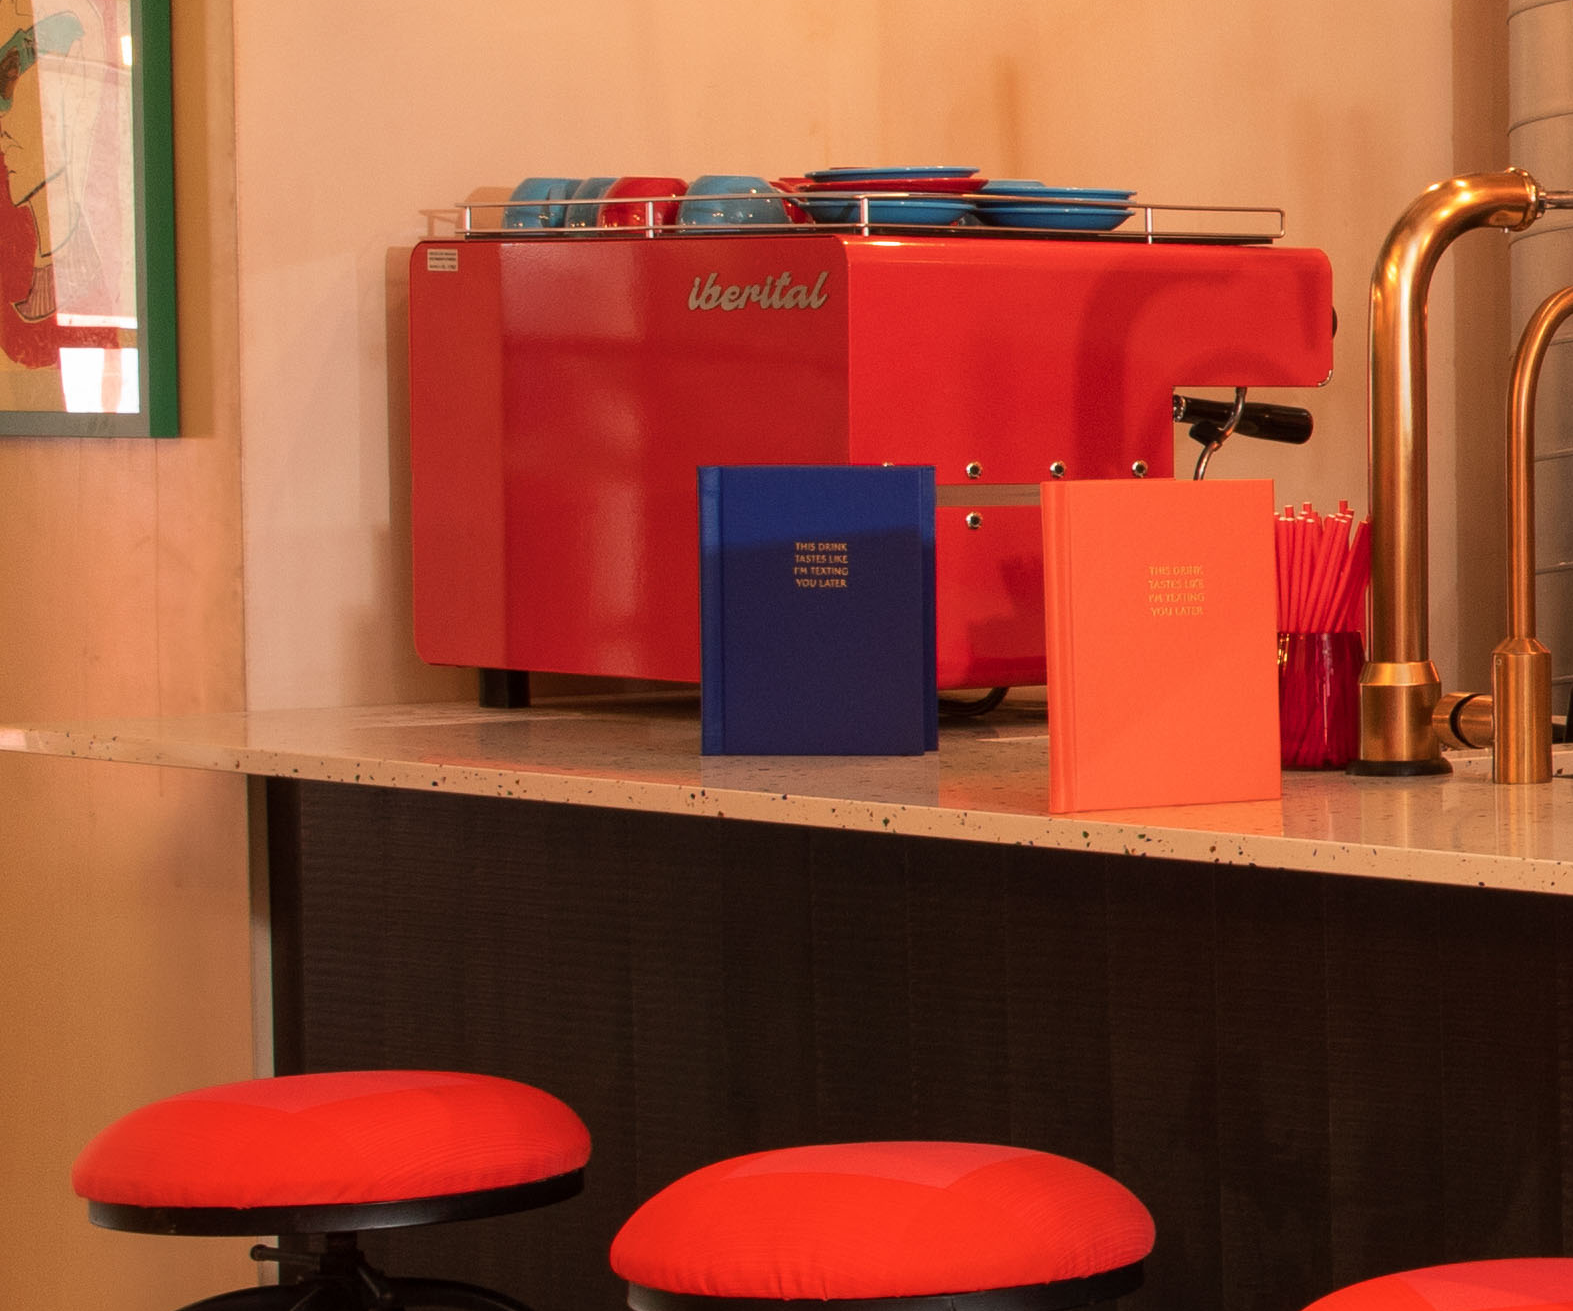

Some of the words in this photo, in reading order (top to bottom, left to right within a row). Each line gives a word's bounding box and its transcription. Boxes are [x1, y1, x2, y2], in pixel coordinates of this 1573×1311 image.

[688, 271, 829, 311] iberital
[795, 542, 815, 551] THIS
[818, 542, 847, 552] DRINK
[795, 554, 827, 564] TASTES
[829, 554, 848, 564] LIKE
[794, 566, 807, 575] I'M
[810, 566, 849, 576] TEXTING
[795, 578, 816, 587] YOU
[819, 578, 847, 588] LATER
